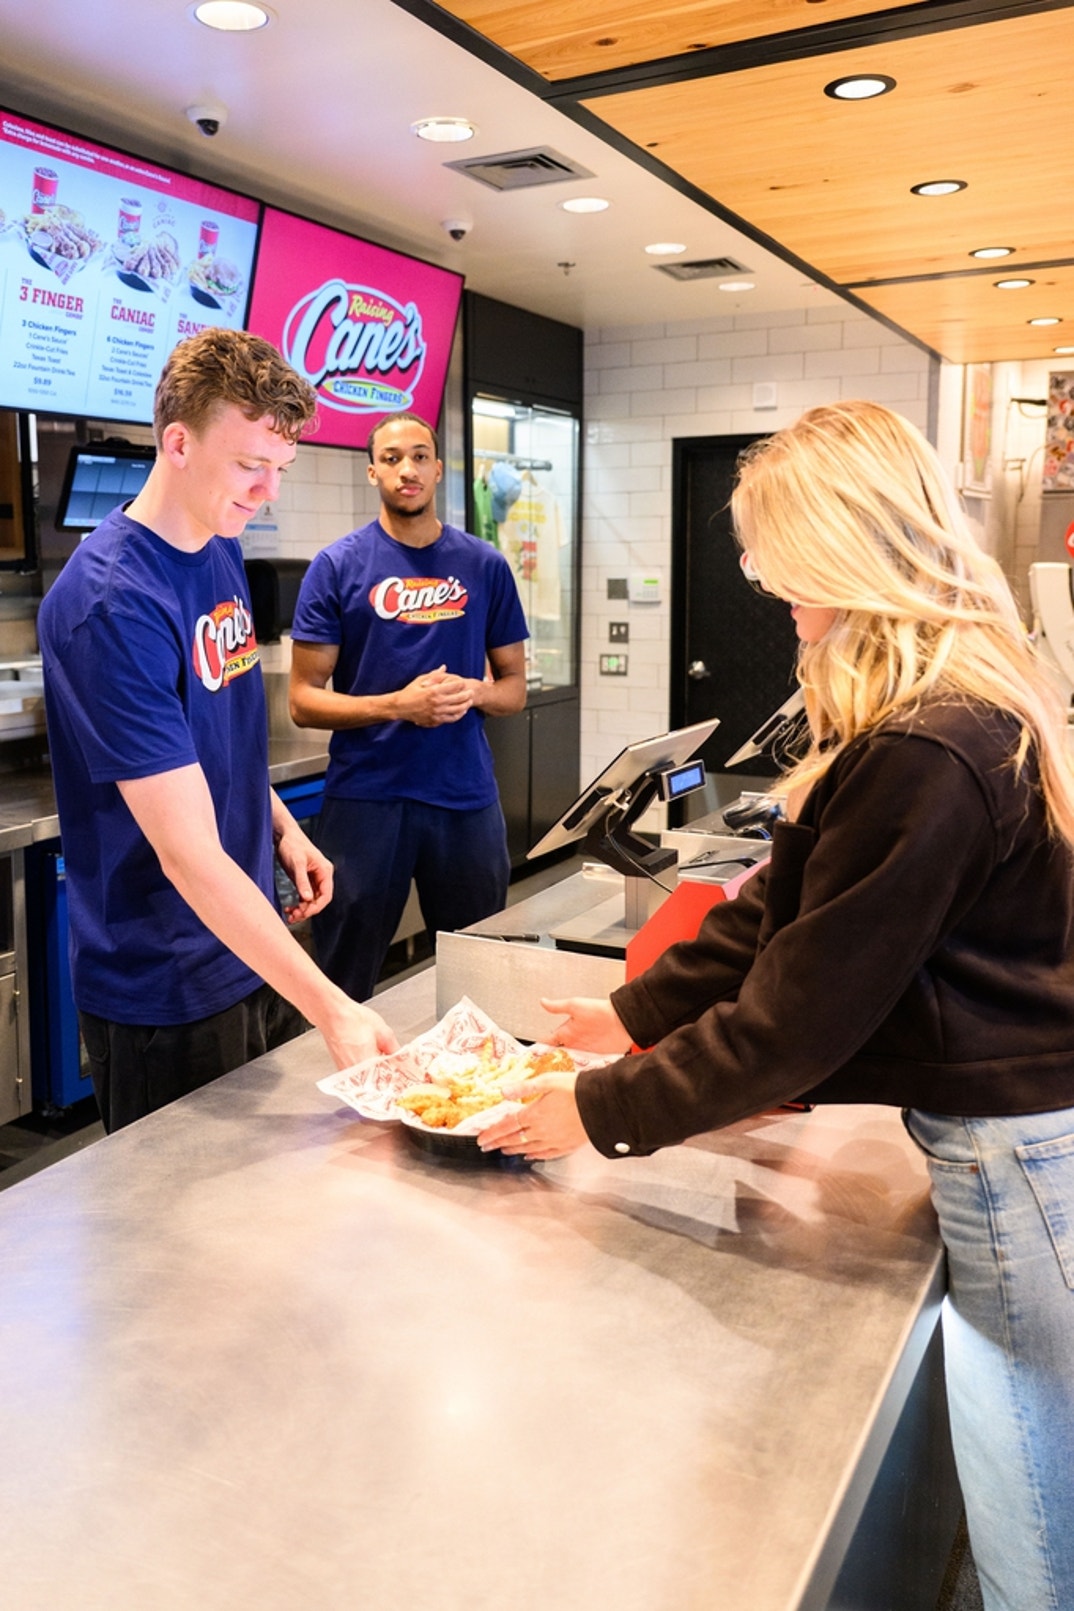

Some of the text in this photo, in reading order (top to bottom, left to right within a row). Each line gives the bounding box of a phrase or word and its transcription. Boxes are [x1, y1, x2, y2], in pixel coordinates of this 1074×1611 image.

[20, 286, 84, 312] 3 FINGER
[350, 294, 394, 326] Raising
[28, 320, 53, 331] Chicken
[54, 326, 77, 336] Fingers
[111, 304, 155, 327] CANIAC
[112, 336, 134, 346] Chicken
[135, 341, 155, 350] Fingers
[290, 280, 424, 388] Cane's
[332, 380, 402, 404] CHICKEN FINGERS
[374, 576, 467, 620] Cane's
